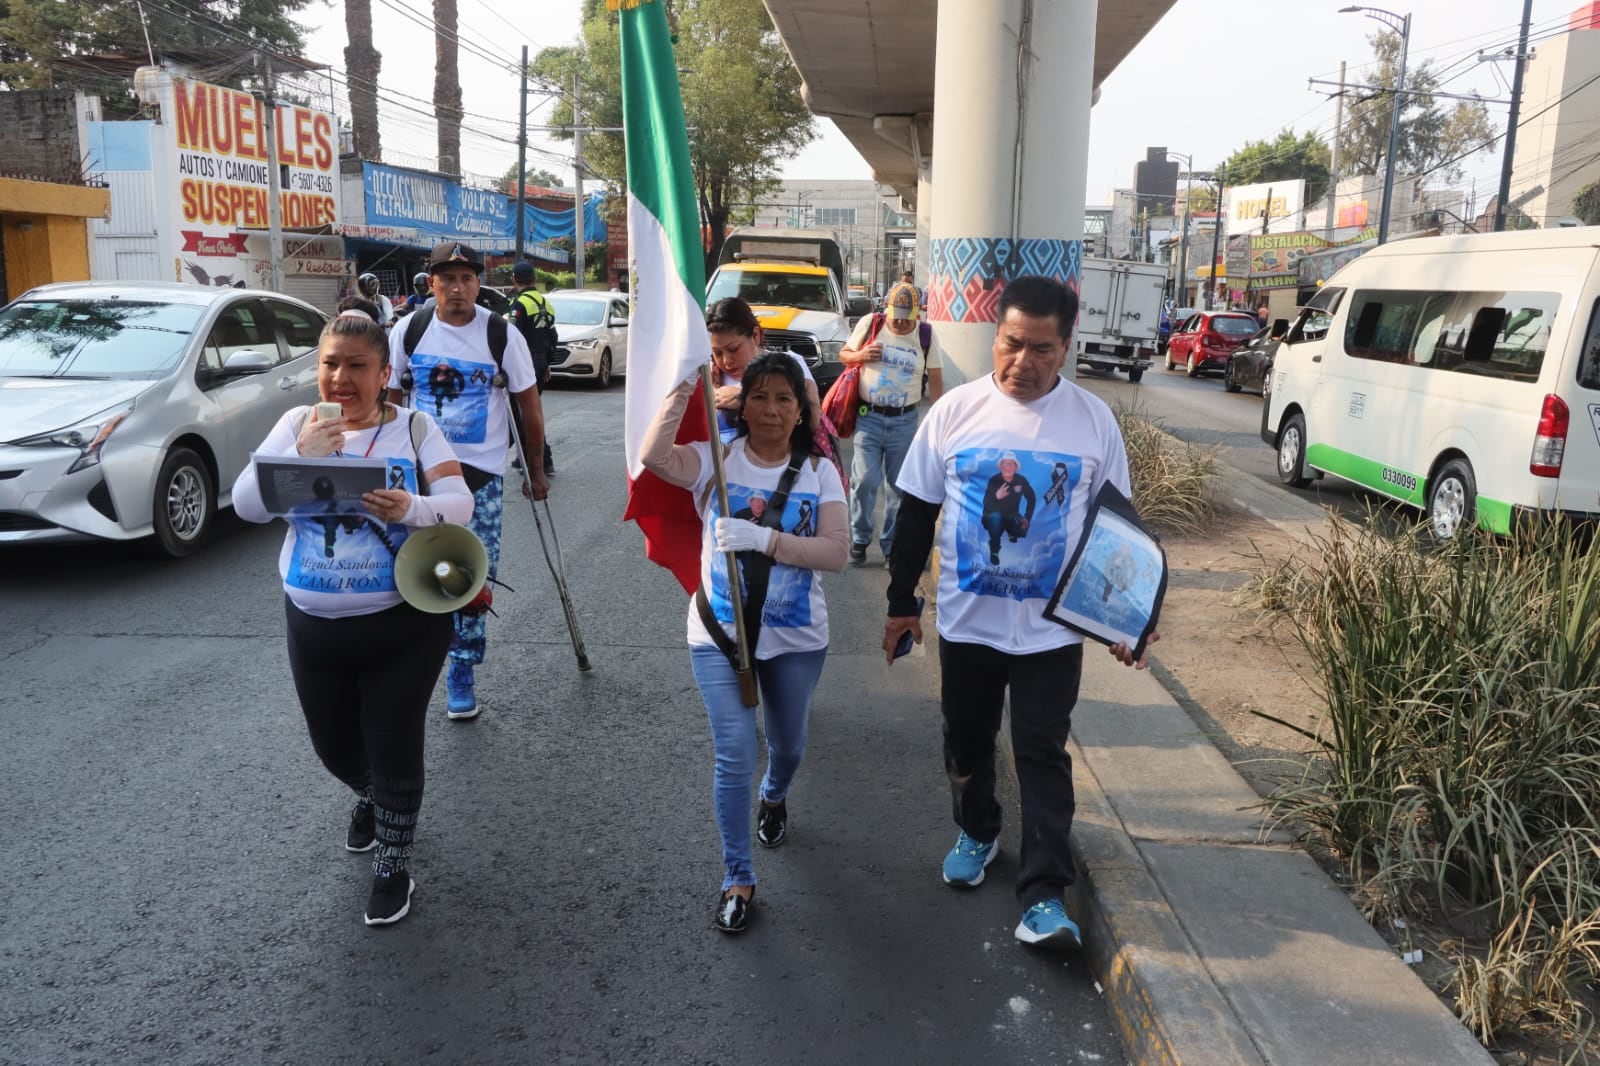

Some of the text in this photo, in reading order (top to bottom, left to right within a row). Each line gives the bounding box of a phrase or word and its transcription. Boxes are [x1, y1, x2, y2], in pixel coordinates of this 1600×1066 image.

[173, 77, 333, 172] MUELLES
[179, 153, 269, 185] AUTOS Y CAMIONE
[286, 240, 325, 257] COCINA
[1382, 467, 1417, 491] 0330099
[300, 556, 393, 573] Miguel Sandoval
